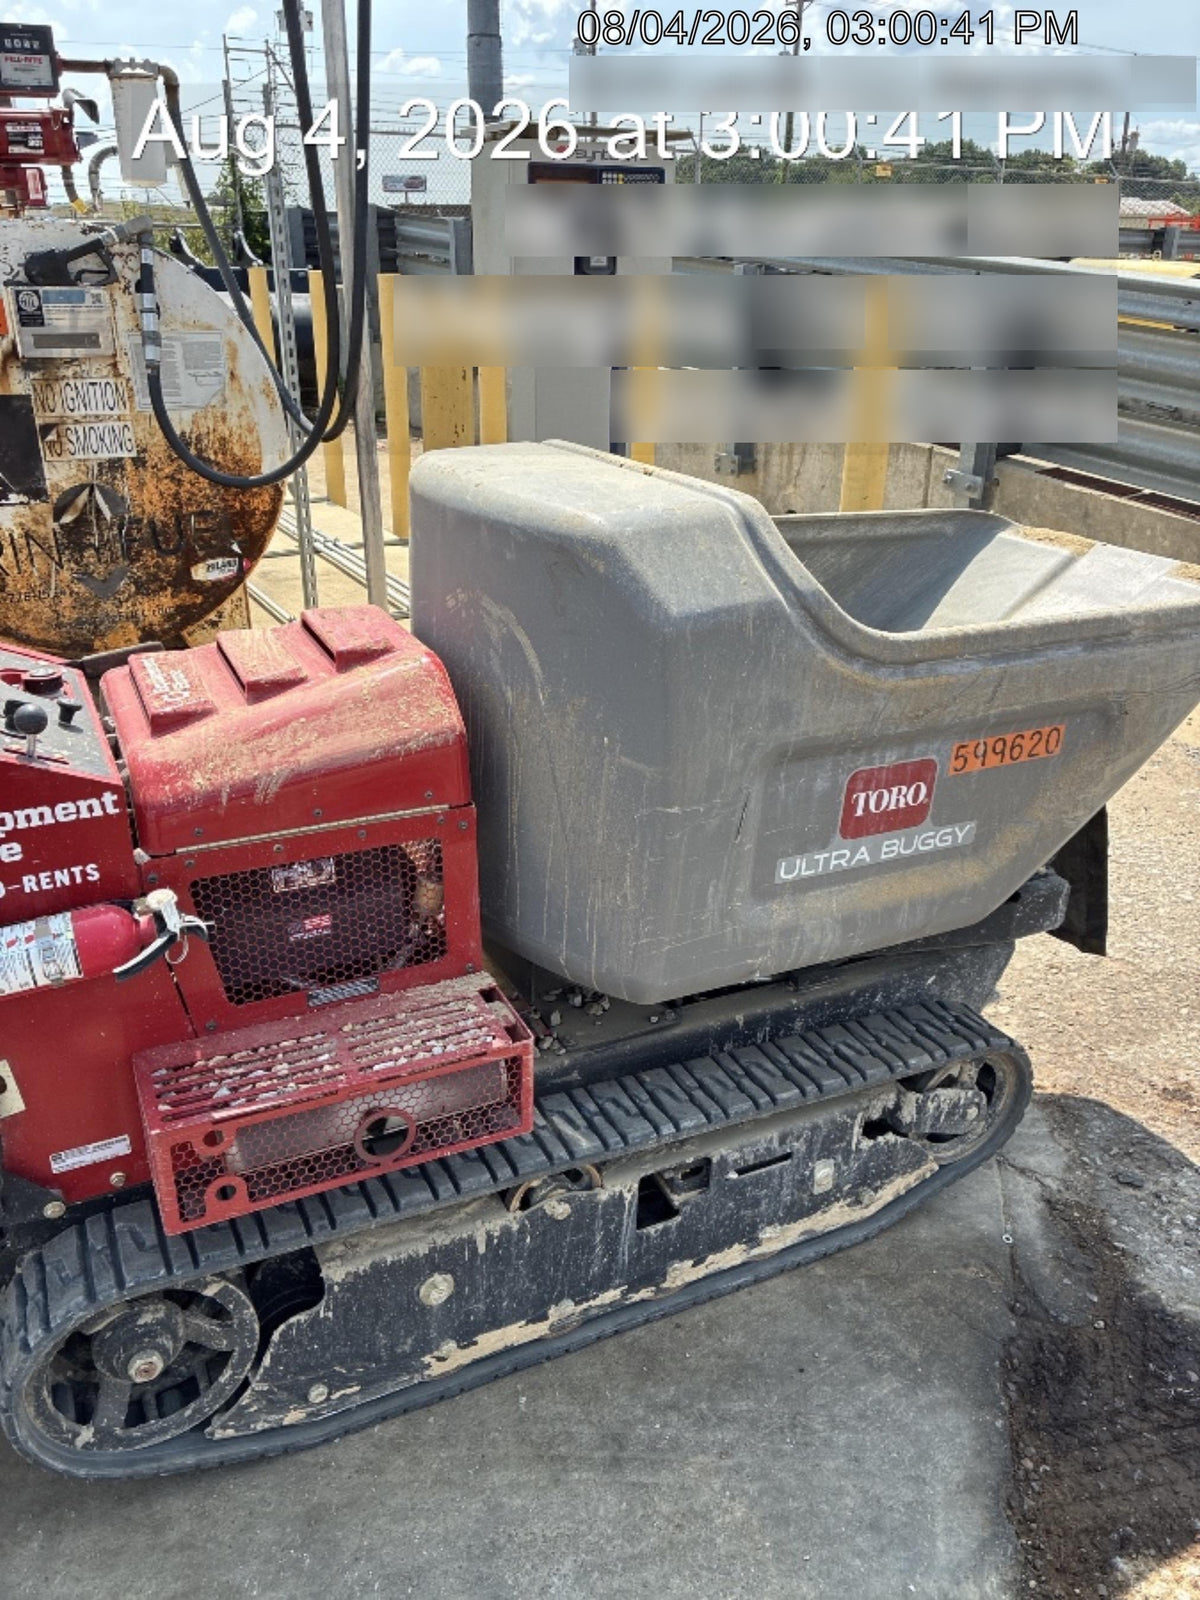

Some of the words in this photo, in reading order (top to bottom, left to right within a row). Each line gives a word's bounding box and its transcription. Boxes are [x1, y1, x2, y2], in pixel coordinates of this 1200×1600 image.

[33, 383, 57, 413] NO
[60, 380, 127, 413] IGNITION
[65, 424, 134, 457] SMOKING
[852, 782, 928, 817] TORO
[780, 846, 870, 879] ULTRA
[880, 824, 972, 860] BUGGY
